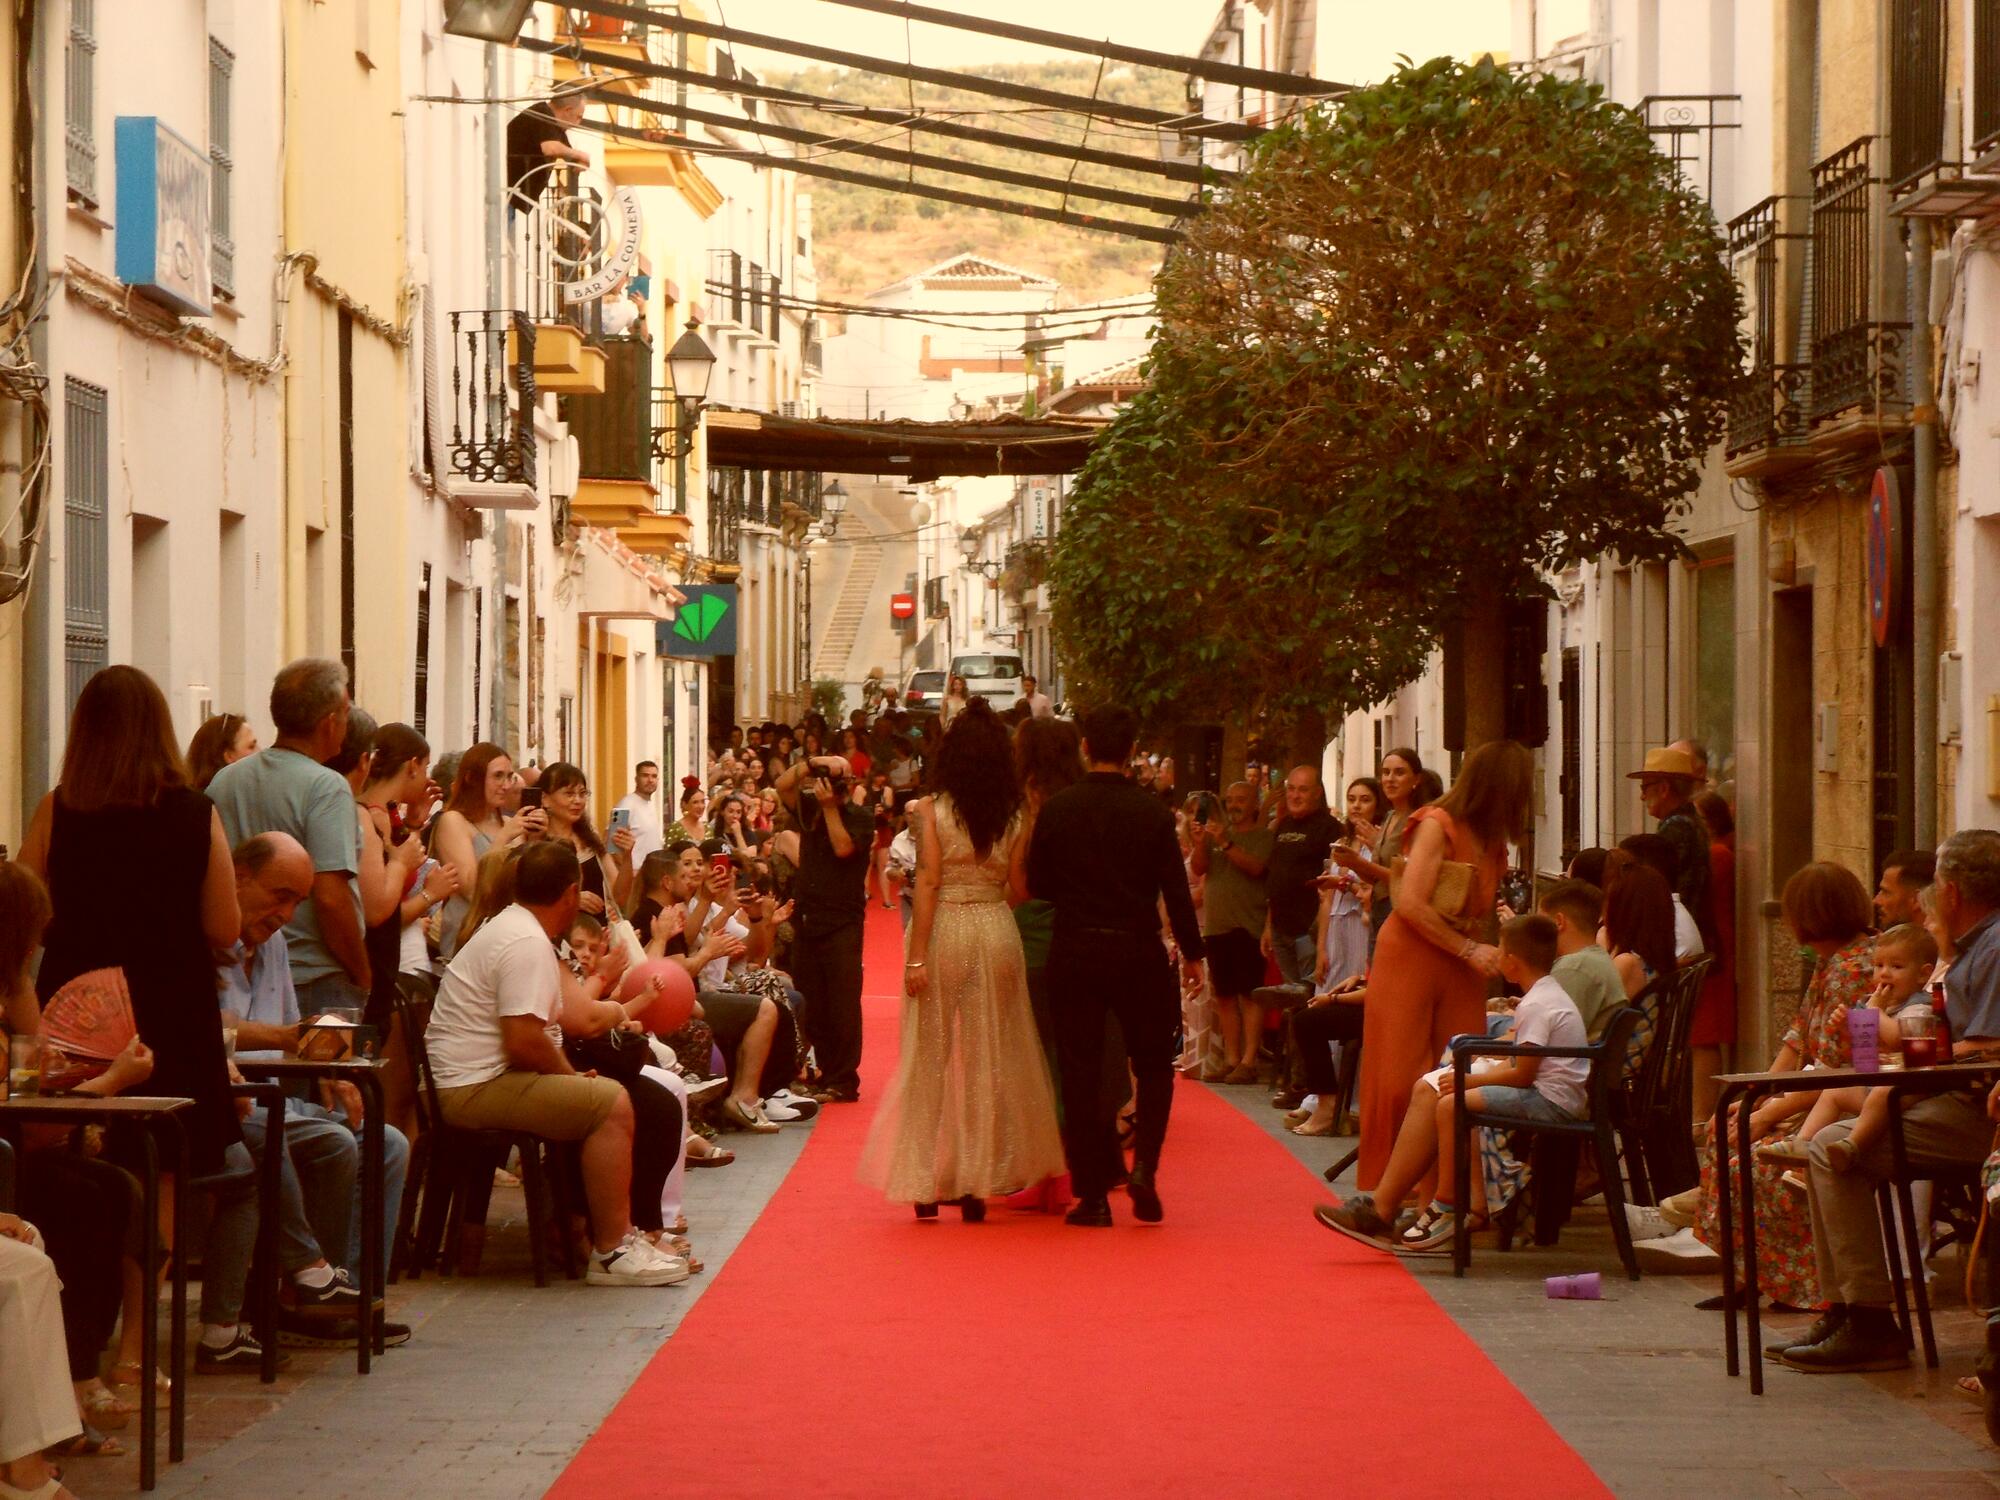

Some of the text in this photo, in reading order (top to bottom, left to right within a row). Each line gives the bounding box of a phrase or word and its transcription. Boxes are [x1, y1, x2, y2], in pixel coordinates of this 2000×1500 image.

[574, 195, 638, 299] BAR LA COLMENA
